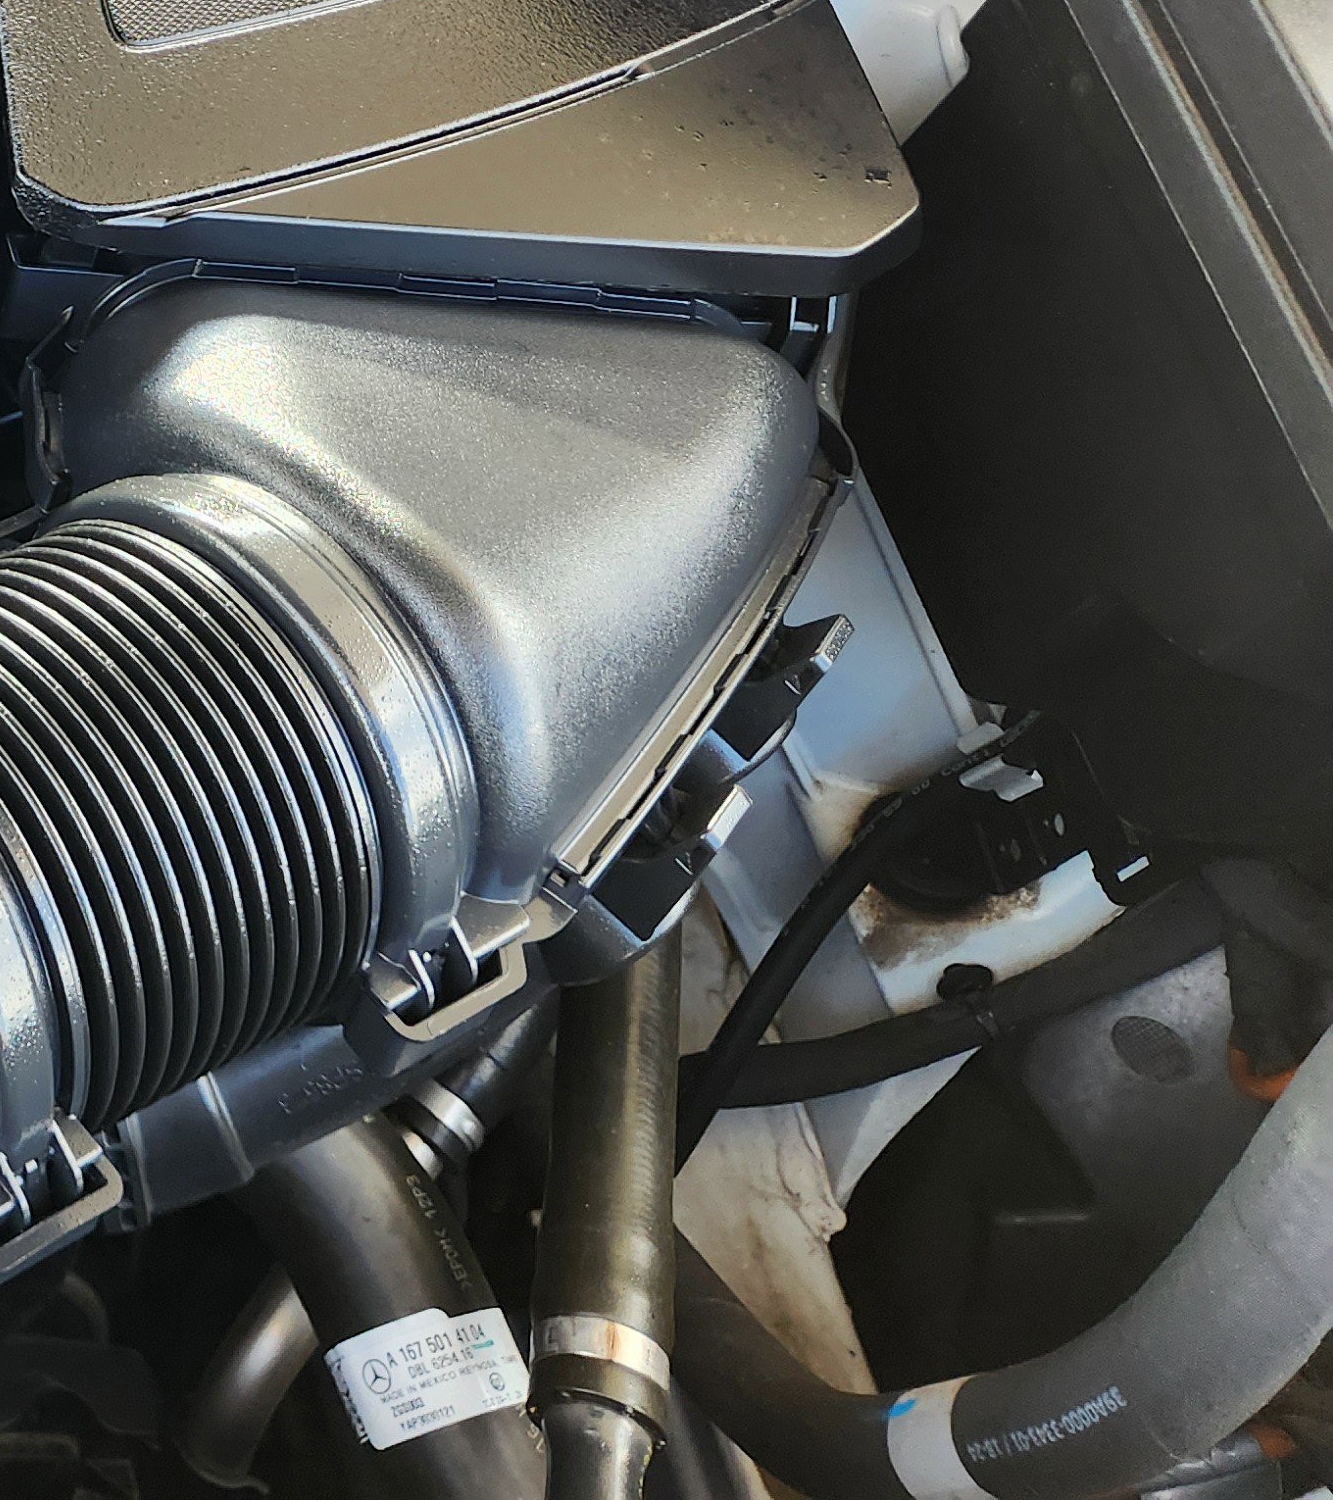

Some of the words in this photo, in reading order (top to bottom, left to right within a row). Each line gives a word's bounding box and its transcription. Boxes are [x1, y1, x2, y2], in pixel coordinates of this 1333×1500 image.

[384, 1351, 397, 1367] A
[399, 1341, 424, 1363] 167
[425, 1331, 452, 1353] 501
[406, 1384, 416, 1394] IN
[418, 1370, 457, 1390] MEXICO
